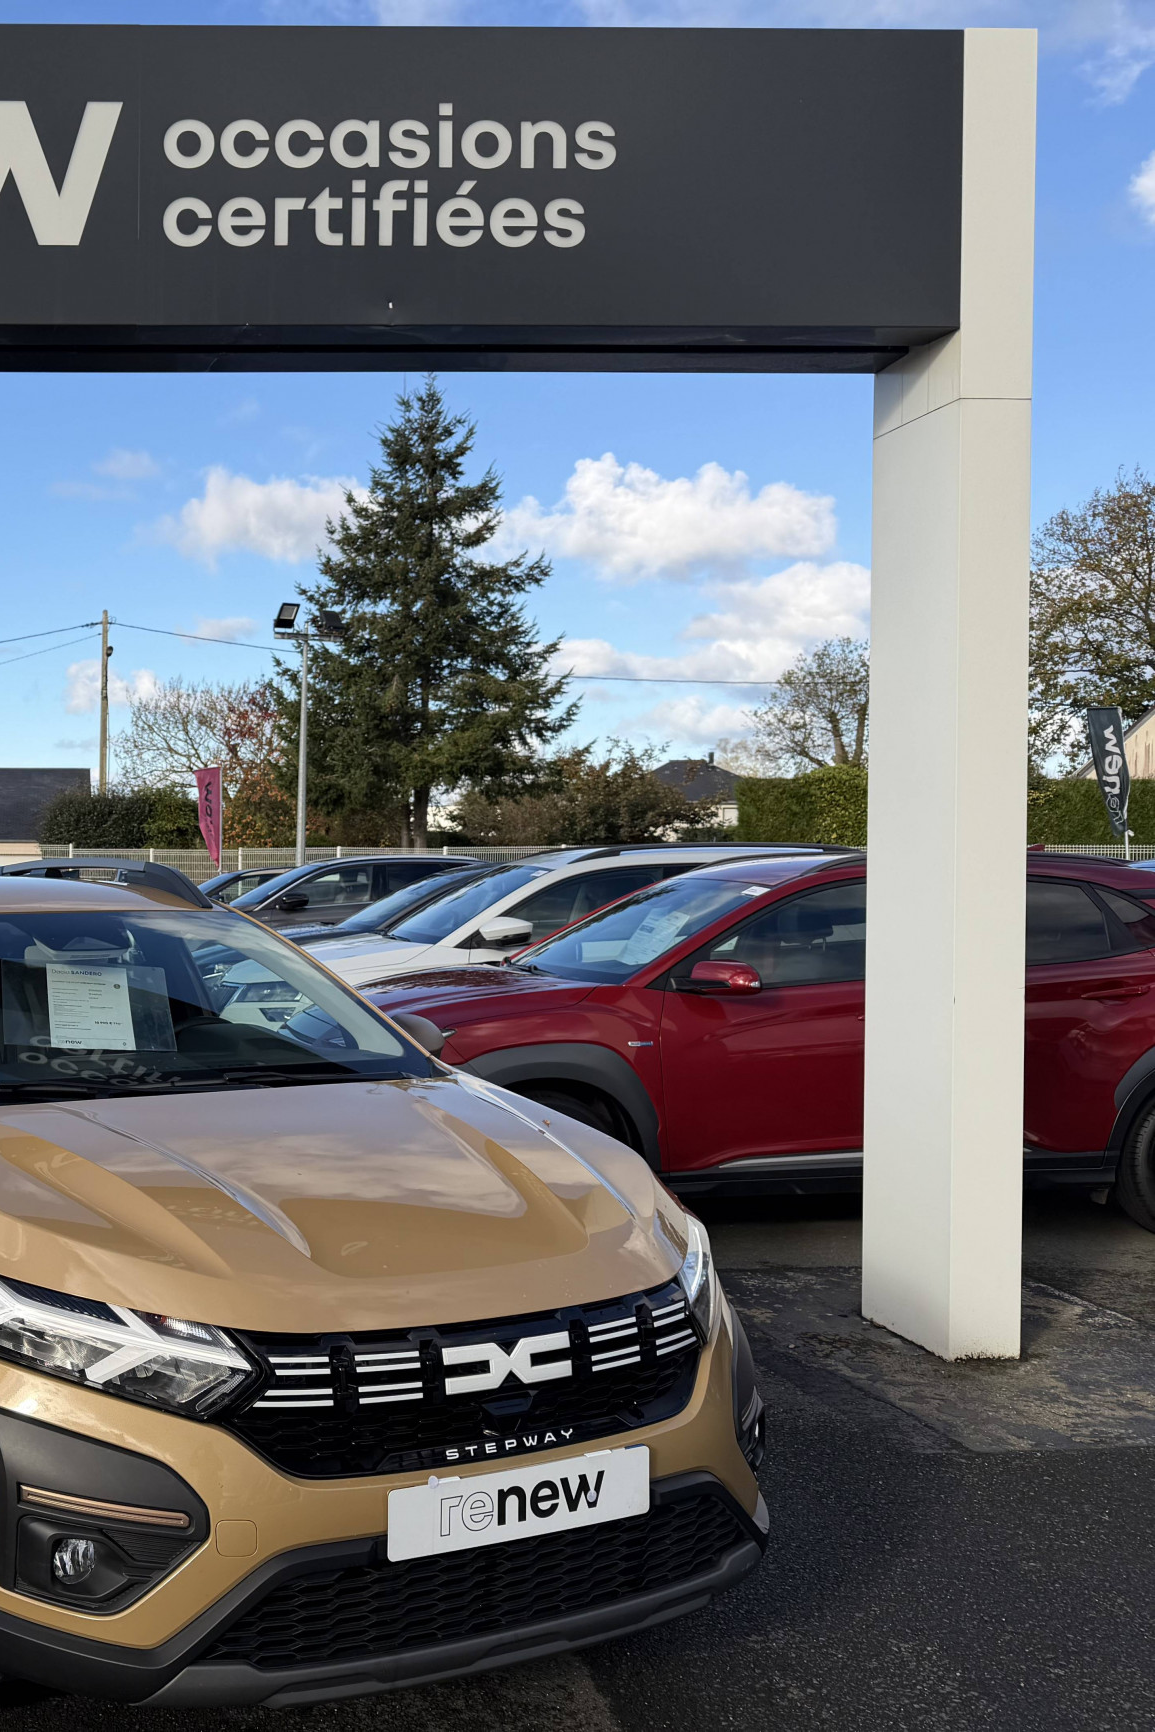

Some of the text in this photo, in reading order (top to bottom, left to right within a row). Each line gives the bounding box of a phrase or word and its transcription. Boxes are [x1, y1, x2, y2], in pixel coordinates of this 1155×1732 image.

[163, 102, 617, 170] occasions
[163, 179, 586, 248] certifiées
[446, 1428, 574, 1460] STEPWAY
[440, 1469, 606, 1537] renew
